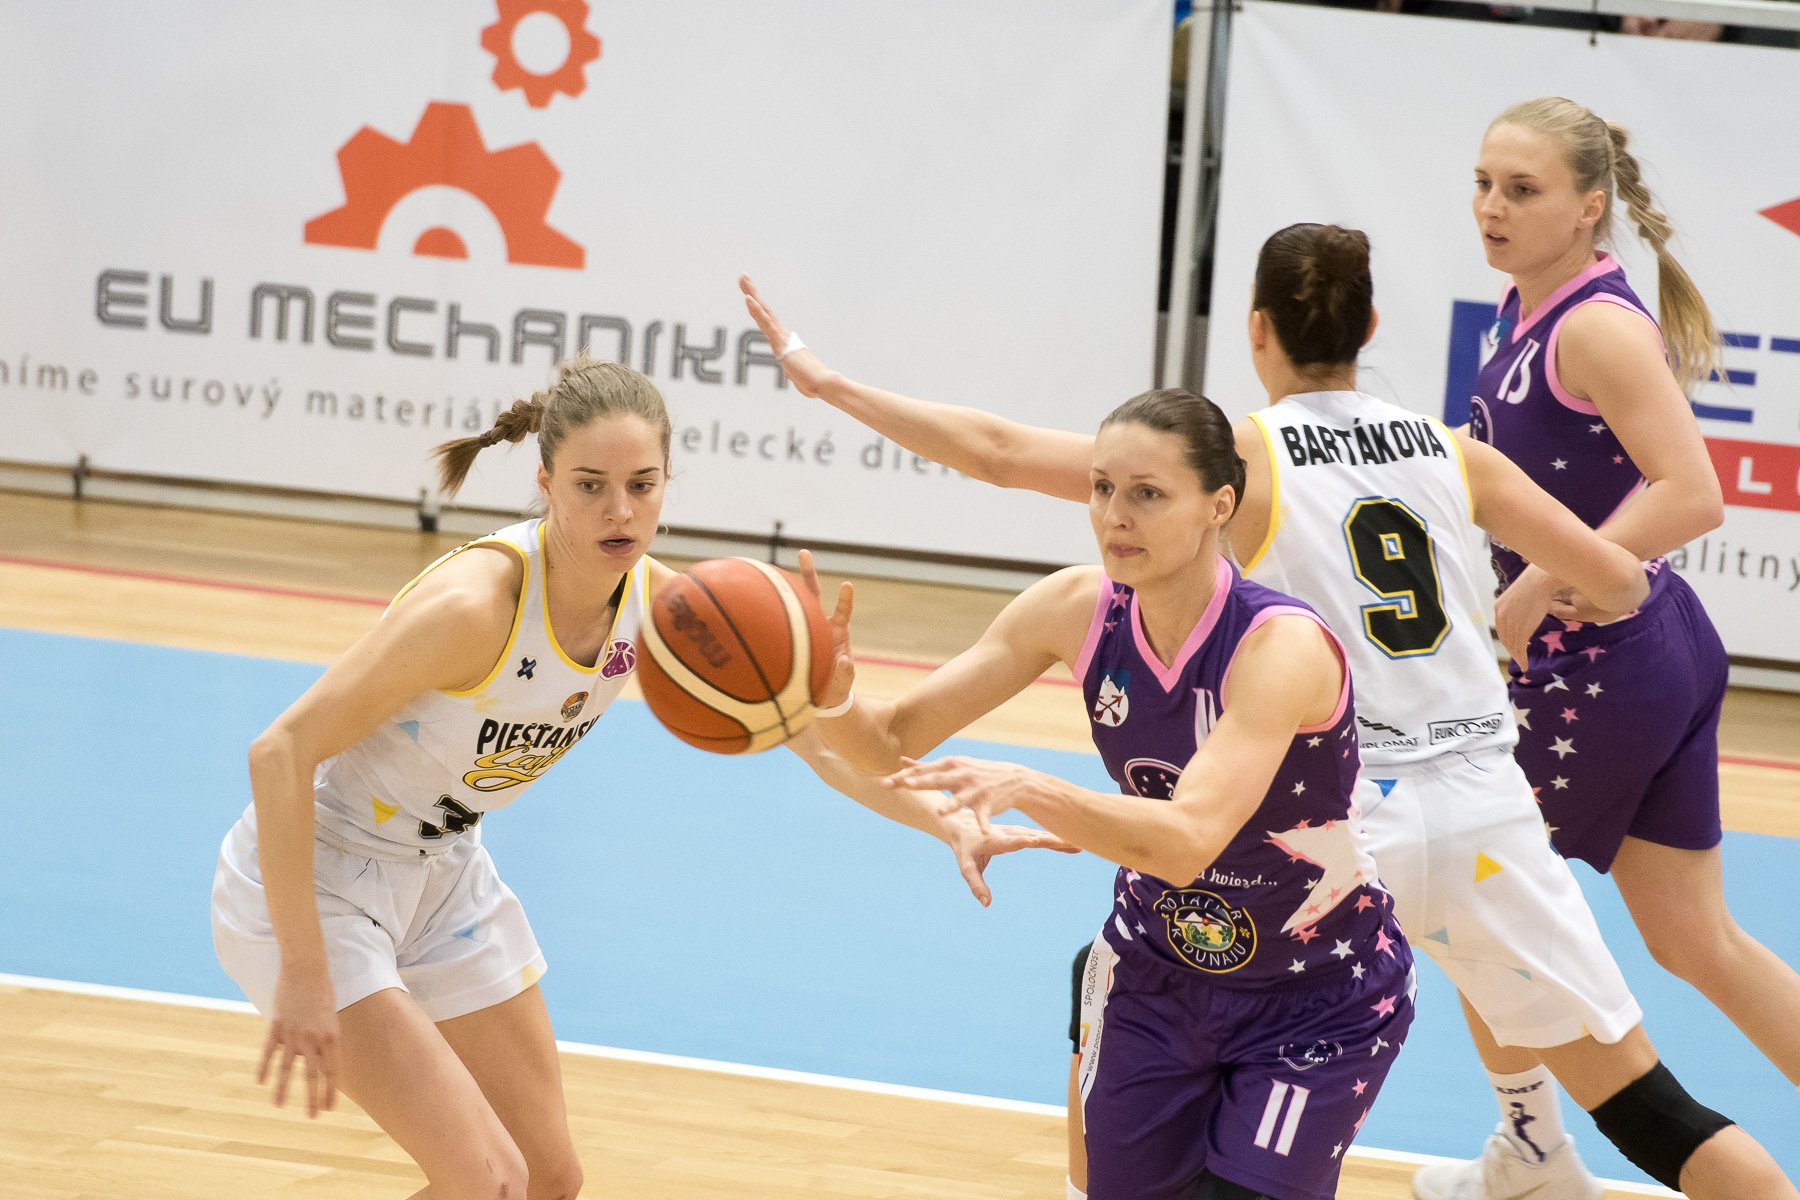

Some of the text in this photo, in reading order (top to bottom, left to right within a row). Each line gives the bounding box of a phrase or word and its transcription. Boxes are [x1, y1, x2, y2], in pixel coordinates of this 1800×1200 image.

[96, 267, 214, 335] EU
[125, 371, 282, 421] surový
[681, 417, 836, 467] elecké
[1280, 417, 1449, 467] BARTÁKOVÁ
[1342, 495, 1453, 661] 9
[1182, 942, 1246, 967] DUNAJU
[1254, 1078, 1312, 1157] 11
